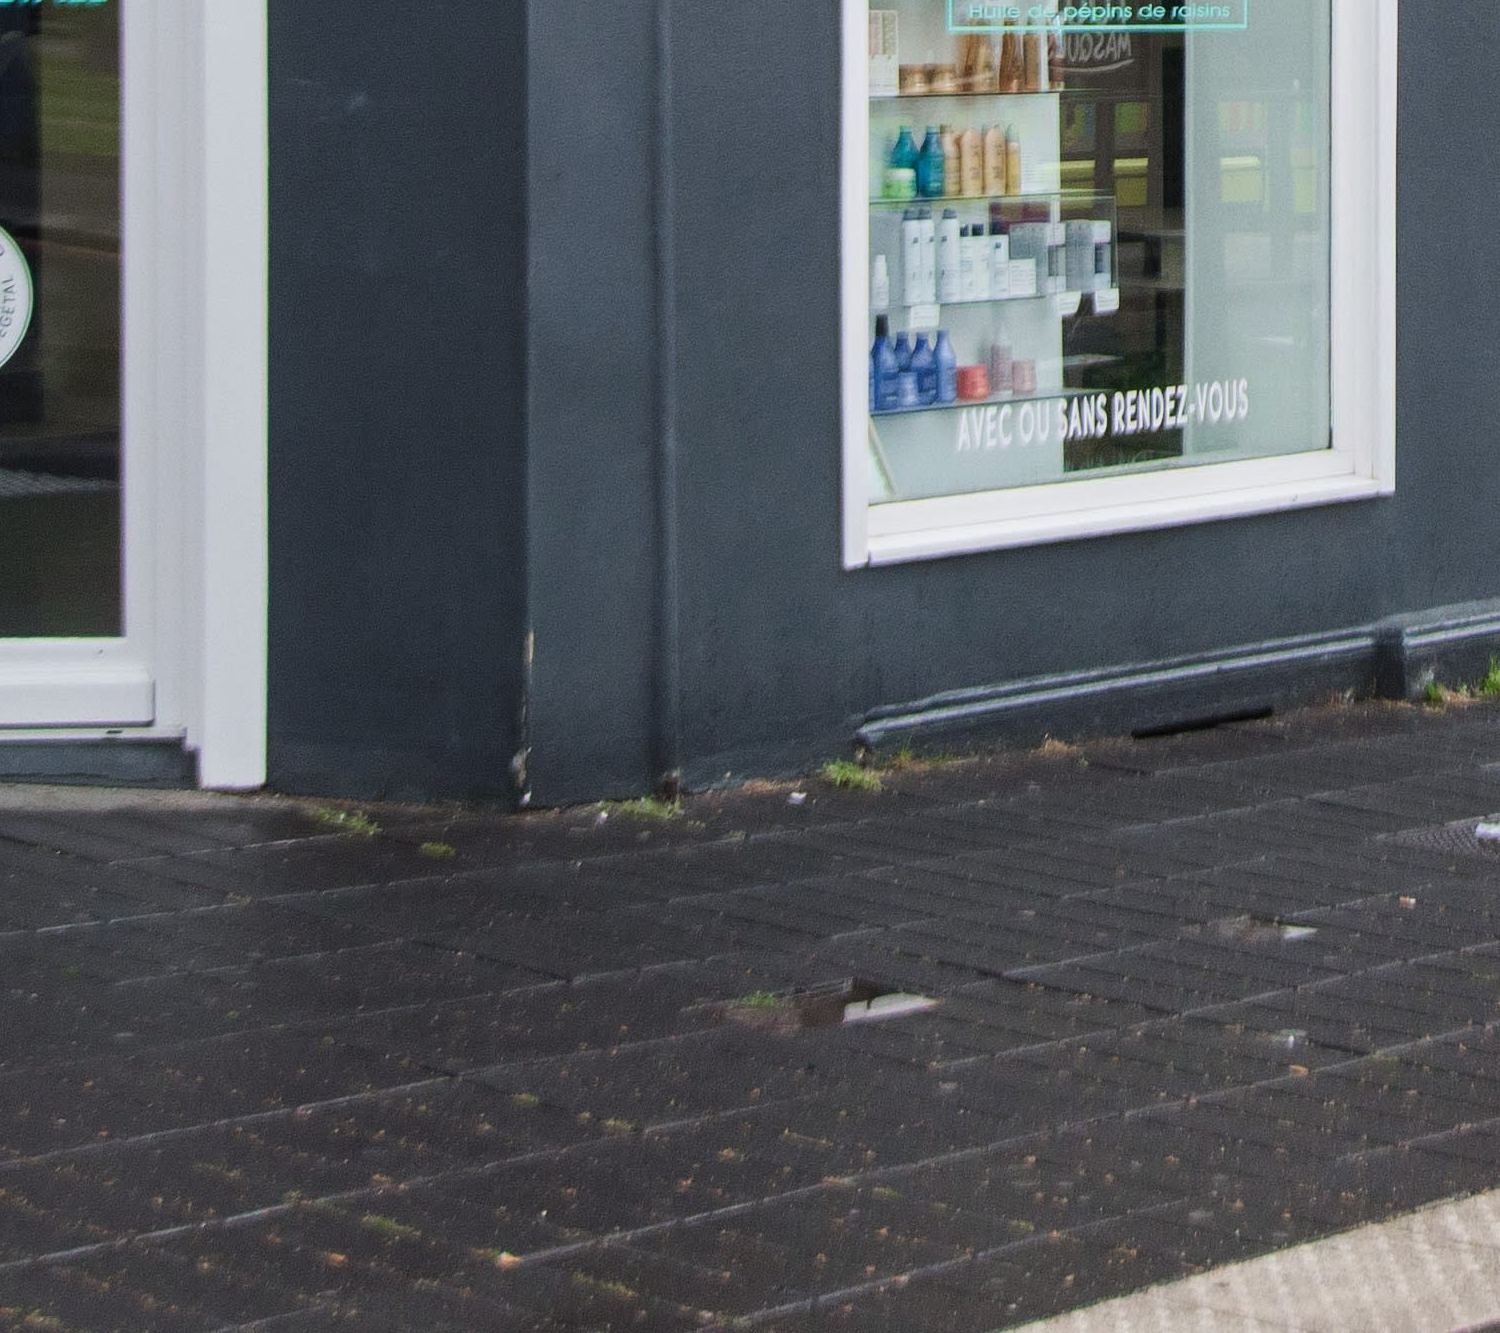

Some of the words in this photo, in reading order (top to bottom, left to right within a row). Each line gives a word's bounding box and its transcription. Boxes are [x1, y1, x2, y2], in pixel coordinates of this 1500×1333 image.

[968, 3, 1021, 20] Huile
[1027, 3, 1051, 20] de
[1063, 2, 1133, 25] pépins
[1138, 3, 1166, 21] de
[1171, 4, 1231, 21] raisins
[956, 403, 1013, 452] AVEC
[1018, 397, 1051, 444] OU
[1056, 392, 1108, 441] SANS
[1111, 377, 1249, 435] RENDEZ-VOUS
